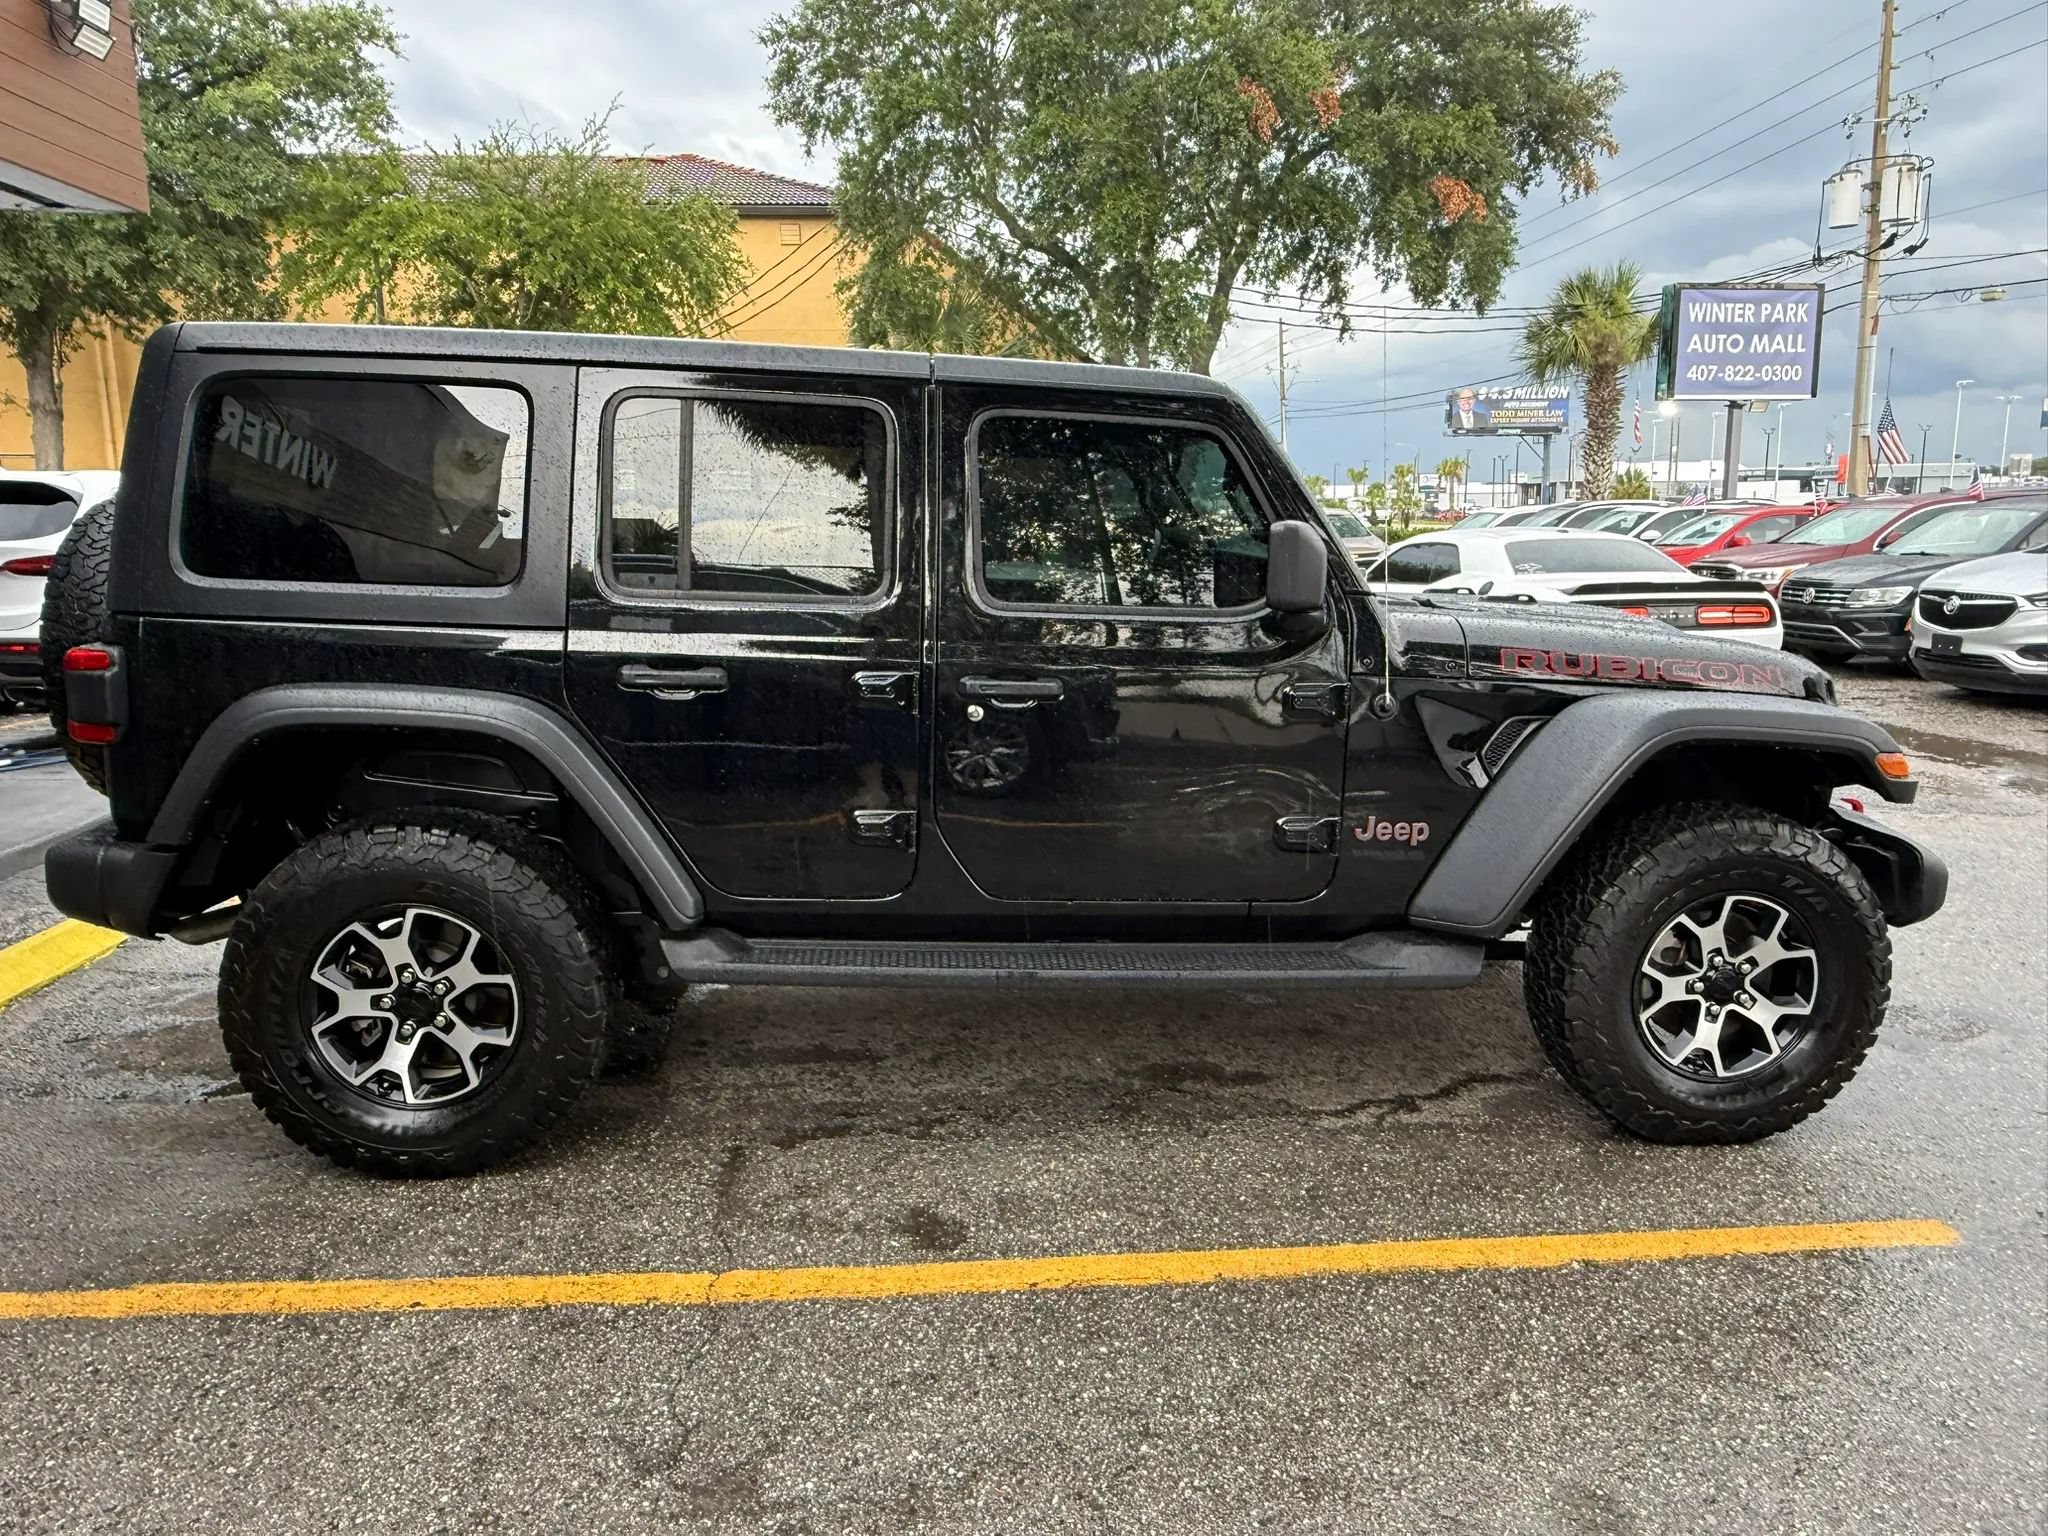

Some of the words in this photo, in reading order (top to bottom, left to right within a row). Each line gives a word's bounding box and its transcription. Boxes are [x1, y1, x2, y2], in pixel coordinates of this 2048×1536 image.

[1688, 302, 1755, 323] WINTER
[1760, 302, 1809, 323] PARK
[1686, 333, 1744, 353] AUTO
[1749, 333, 1806, 353] MALL
[1686, 364, 1802, 382] 407-822-0300
[1513, 386, 1570, 400] MILLION
[1490, 410, 1516, 418] TODD
[1517, 409, 1544, 417] MINER
[1546, 409, 1564, 417] LAW
[1500, 647, 1784, 688] RUBICON
[1354, 815, 1430, 847] Jeep
